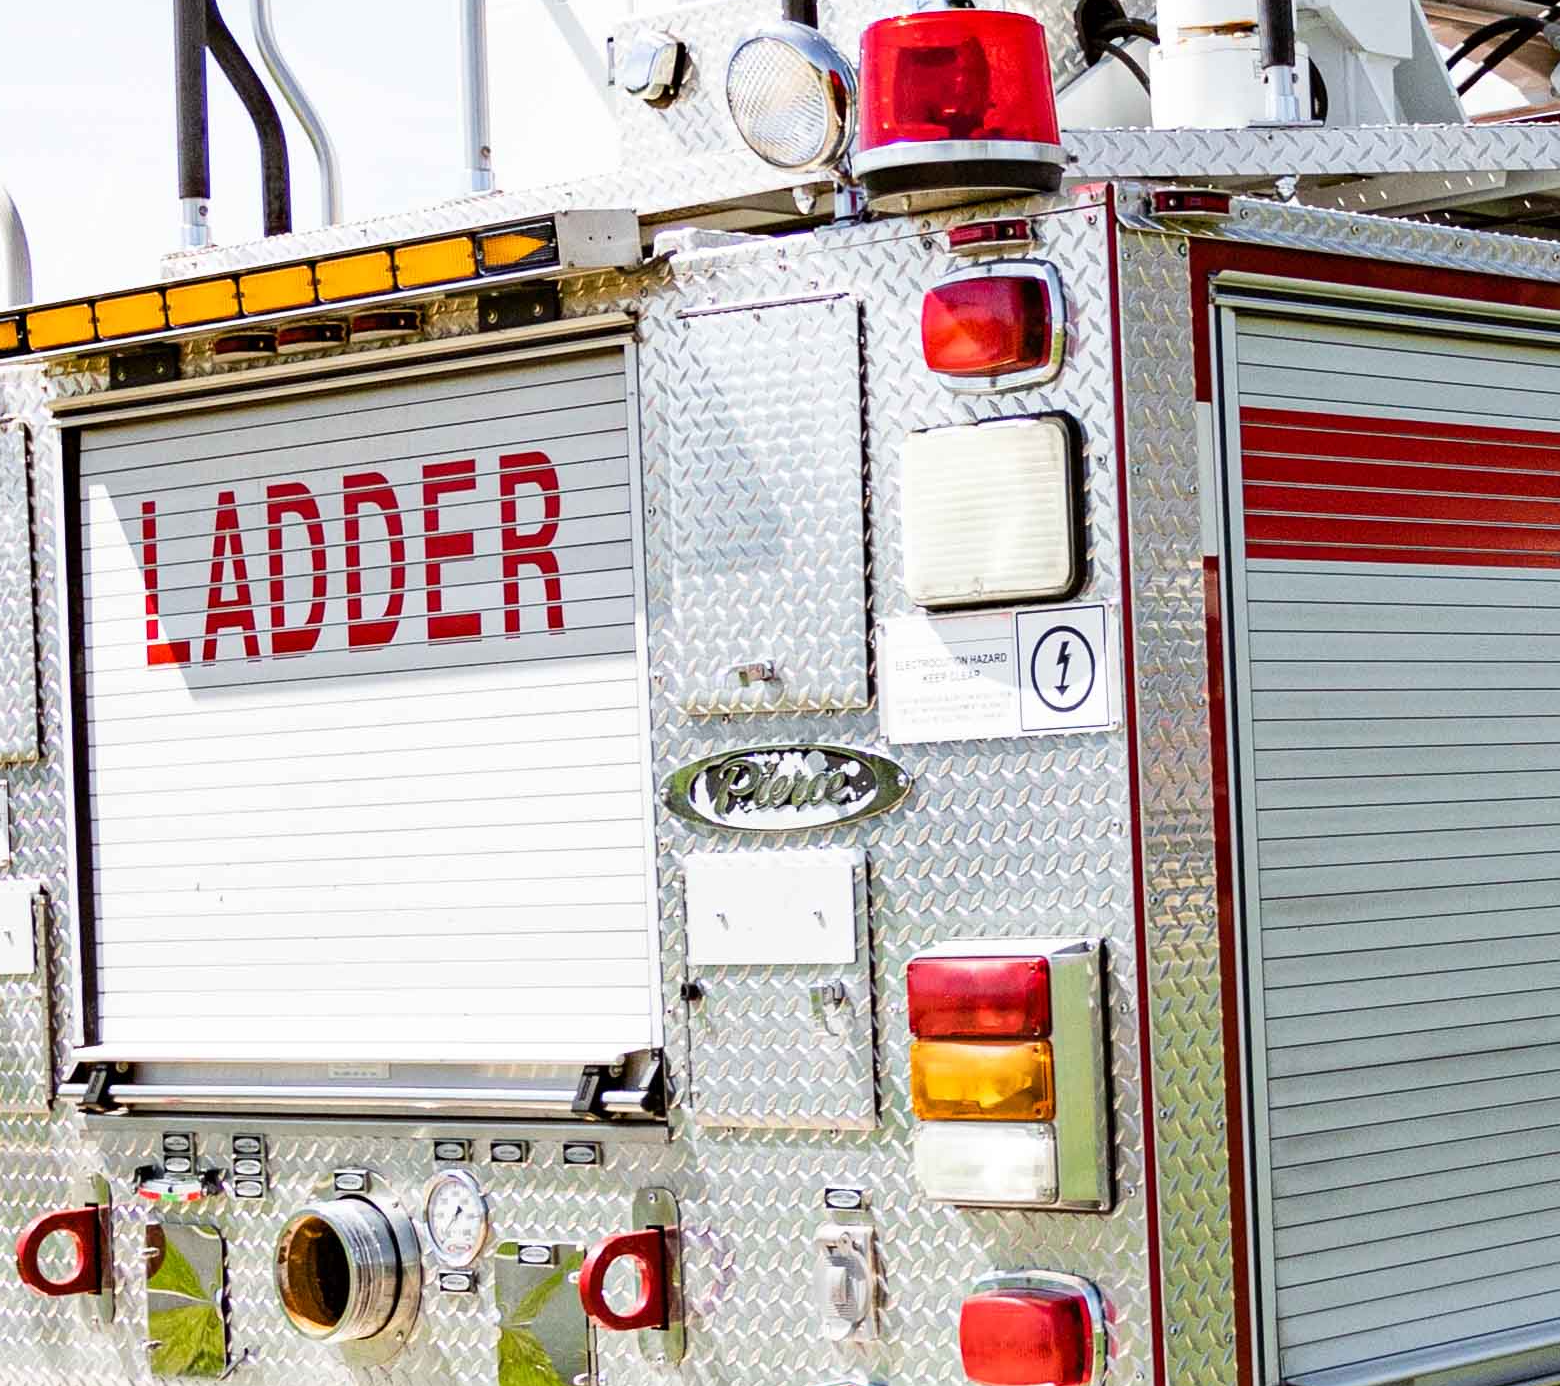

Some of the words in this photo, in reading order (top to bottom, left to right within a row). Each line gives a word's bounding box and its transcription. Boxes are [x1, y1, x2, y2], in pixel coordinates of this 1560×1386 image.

[142, 450, 566, 669] LADDER
[895, 655, 968, 672] ELECTROCUON
[970, 653, 1008, 664] HAZARD
[714, 758, 847, 816] Pierce
